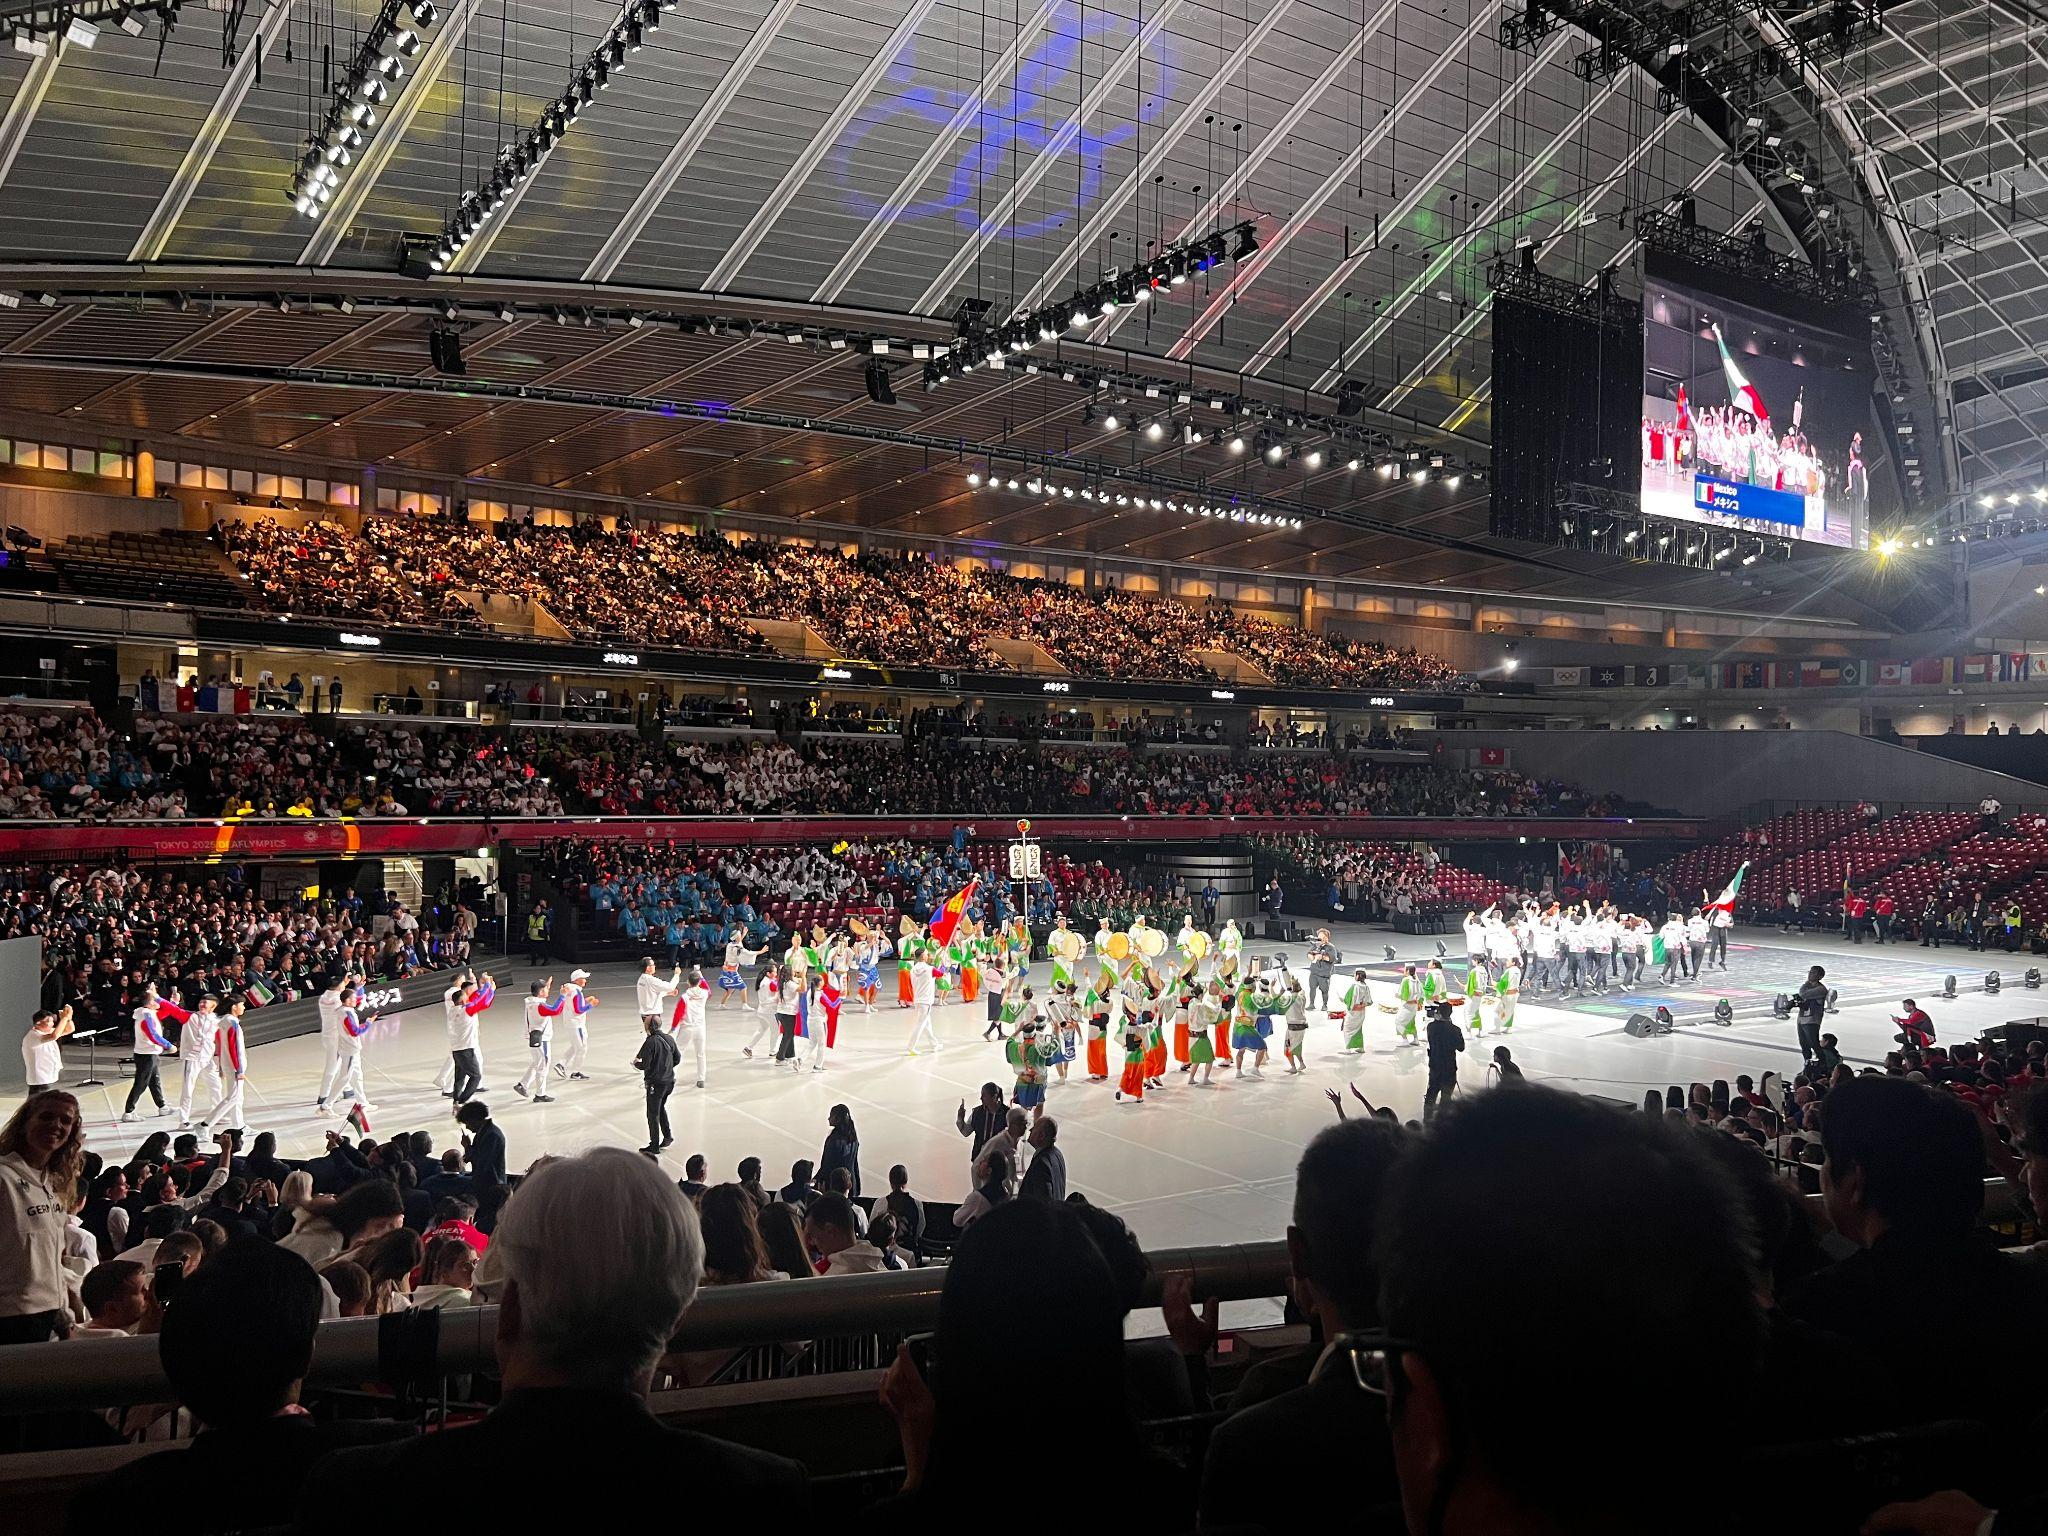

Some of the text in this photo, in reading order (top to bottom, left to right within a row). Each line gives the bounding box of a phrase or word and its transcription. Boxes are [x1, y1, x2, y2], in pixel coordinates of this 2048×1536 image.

[1713, 482, 1738, 496] Mexico
[1713, 496, 1739, 510] メキシコ
[154, 841, 189, 849] TOKYO
[192, 840, 216, 849] 2025
